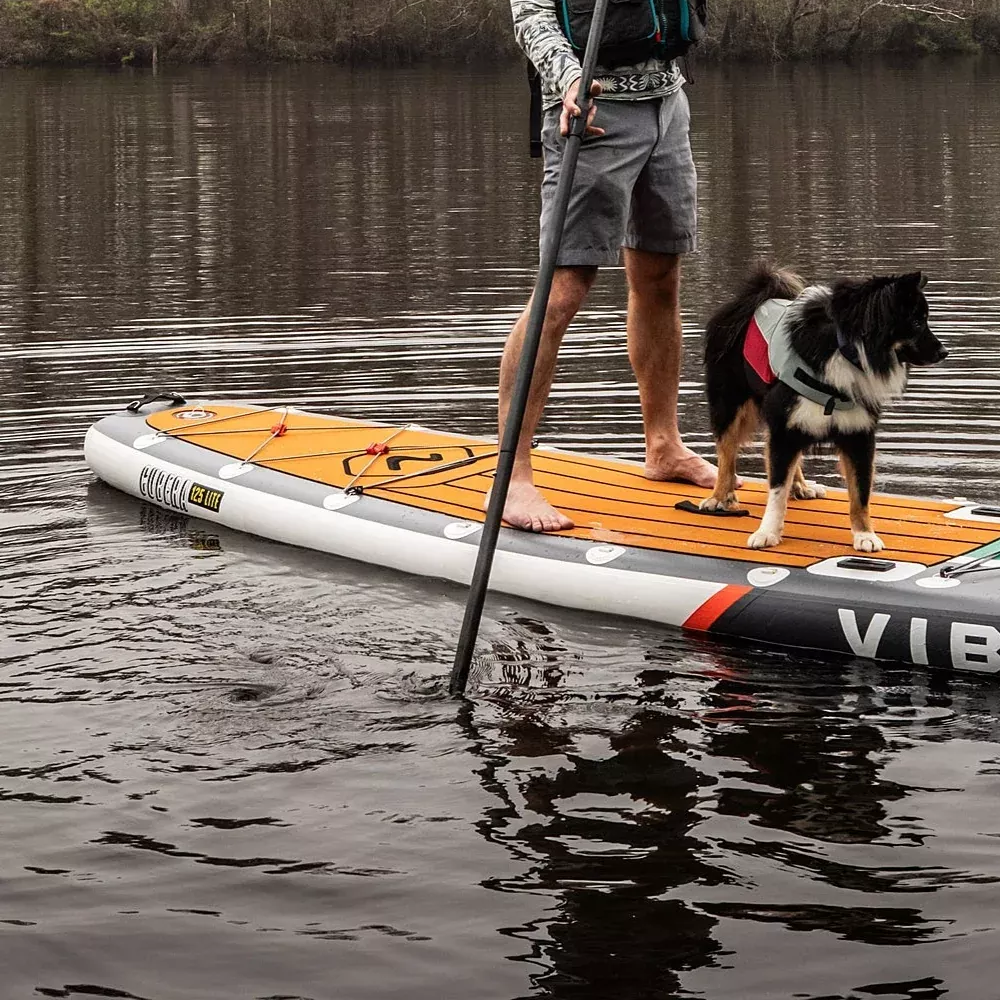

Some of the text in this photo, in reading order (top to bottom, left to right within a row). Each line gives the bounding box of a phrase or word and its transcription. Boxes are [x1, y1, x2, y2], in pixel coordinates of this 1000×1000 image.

[140, 465, 221, 512] CUBERA 125 LITE
